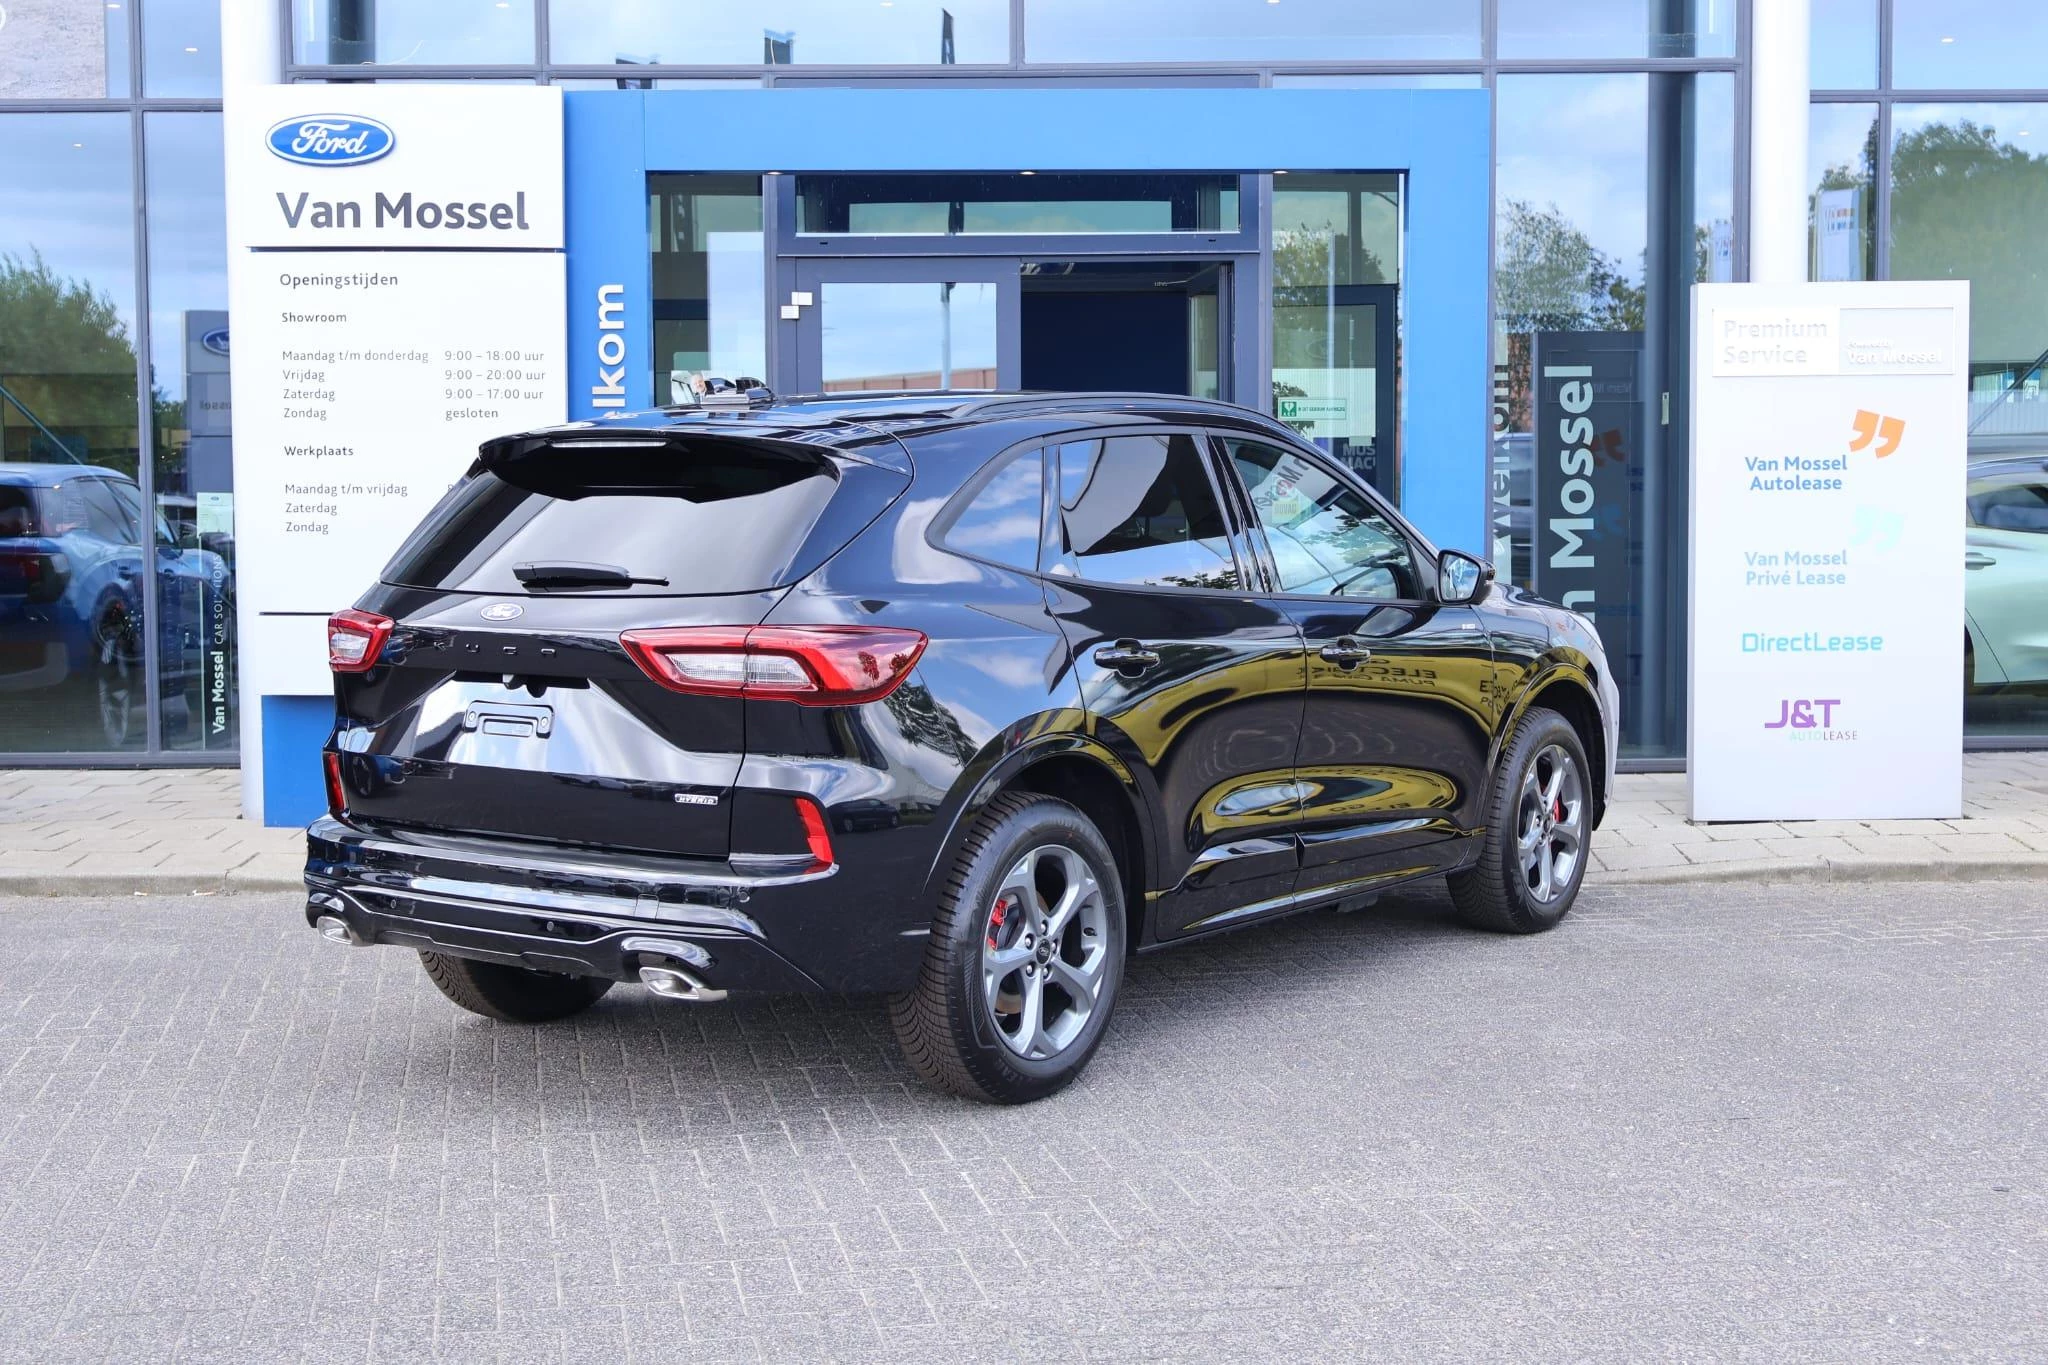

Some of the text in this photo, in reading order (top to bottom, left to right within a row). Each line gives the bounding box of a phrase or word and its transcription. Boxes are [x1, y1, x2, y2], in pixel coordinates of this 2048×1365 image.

[291, 120, 369, 156] Ford
[276, 191, 530, 230] Van Mossel
[280, 272, 398, 289] Openingstijden
[281, 312, 347, 323] Showroom
[1723, 318, 1828, 338] Premium
[282, 350, 336, 363] Maandag
[339, 351, 361, 362] t/m
[364, 350, 429, 363] donderdag
[444, 350, 473, 361] 9:00
[486, 350, 521, 361] 18:00
[524, 352, 545, 361] uur
[592, 284, 626, 416] lkom
[1723, 345, 1807, 364] Service
[1848, 347, 1942, 365] Van Mossel
[282, 369, 325, 383] Vrijdag
[444, 369, 473, 381] 9:00
[486, 369, 522, 381] 20:00
[526, 372, 546, 381] uur
[283, 388, 335, 402] Zaterdag
[445, 388, 473, 400] 9:00
[487, 388, 520, 400] 17:00
[523, 391, 544, 400] uur
[283, 407, 499, 421] Zondag gesloten
[284, 446, 354, 459] Werkplaats
[1544, 365, 1595, 568] Mossel
[1744, 454, 1848, 471] Van Mossel
[285, 483, 408, 497] Maandag t/m vrijdag
[1750, 475, 1843, 491] Autolease
[285, 502, 338, 516] Zaterdag
[285, 521, 329, 535] Zondag
[1744, 549, 1848, 566] Van Mossel
[1745, 570, 1847, 586] Privé Lease
[214, 622, 224, 645] CAR
[1741, 632, 1884, 652] DirectLease
[210, 650, 225, 702] Mossel
[212, 706, 226, 735] Van
[1764, 699, 1842, 729] J&T
